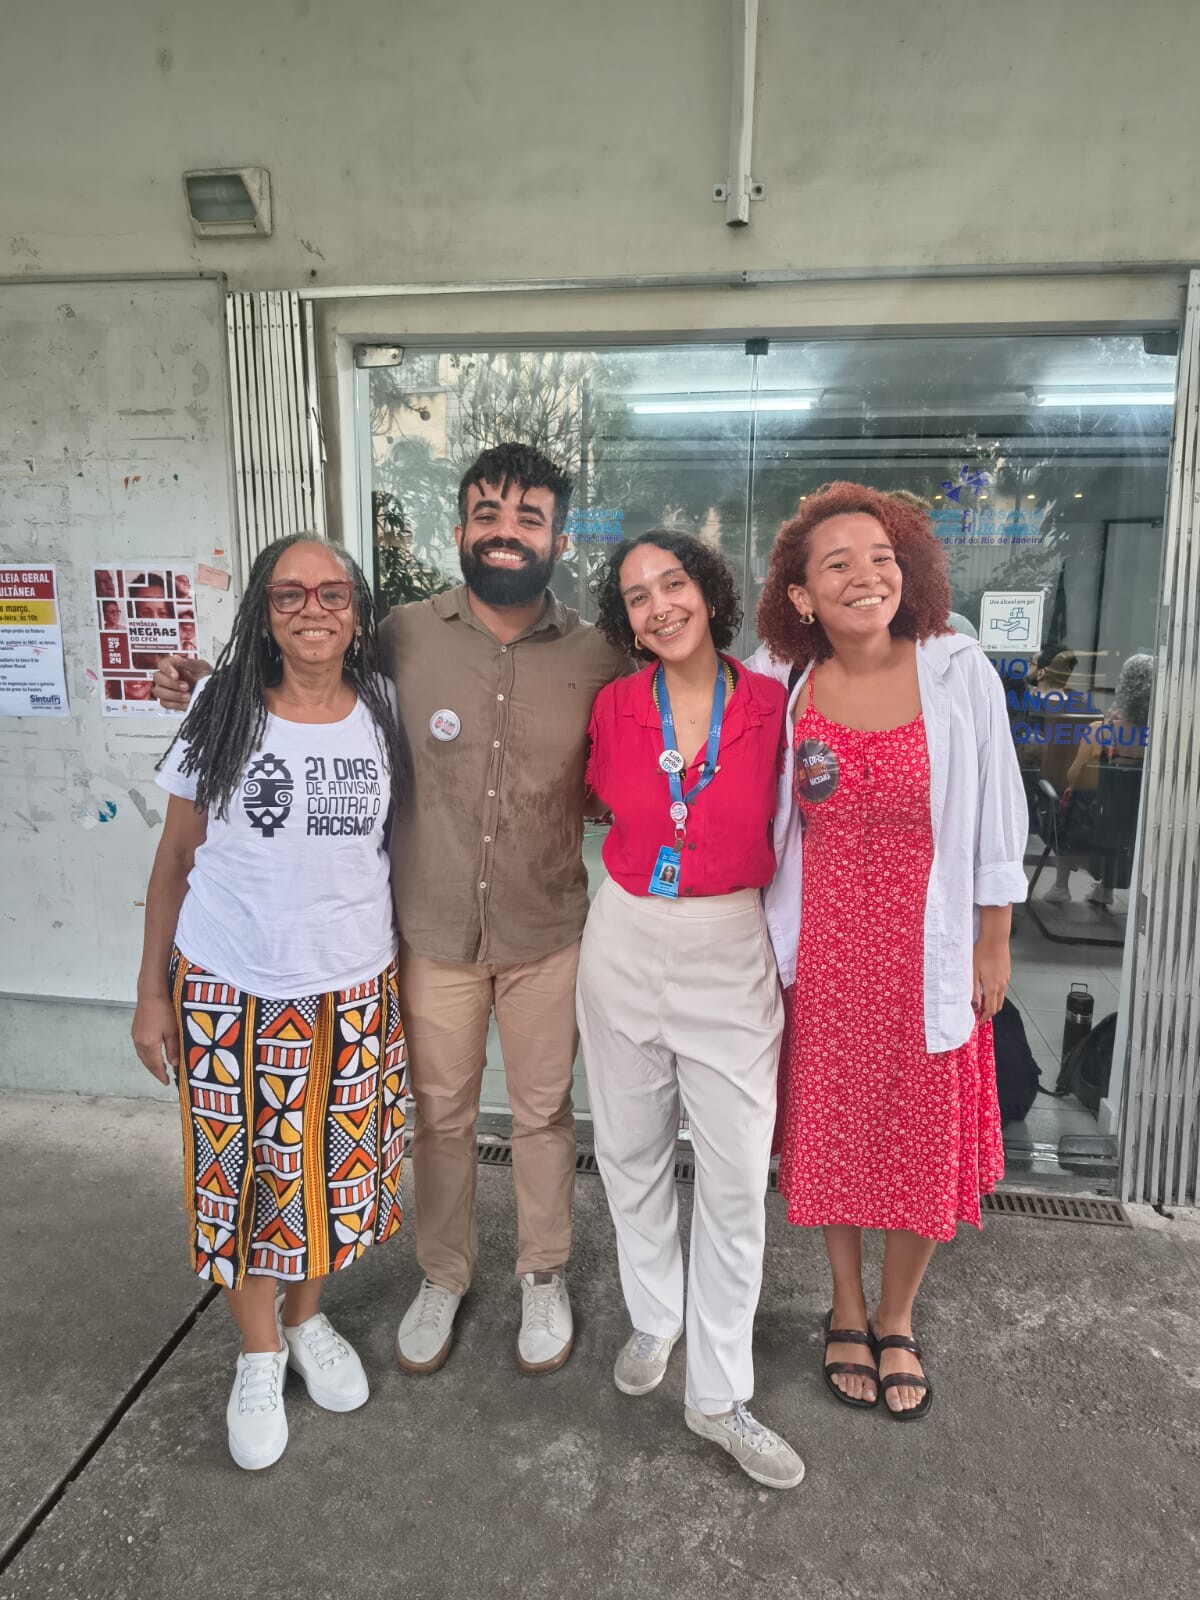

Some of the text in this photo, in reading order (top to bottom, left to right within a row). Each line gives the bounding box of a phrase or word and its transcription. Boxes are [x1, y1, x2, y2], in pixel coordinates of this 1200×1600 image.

[981, 536, 996, 545] Rio
[1010, 536, 1043, 545] Janeiro
[22, 573, 51, 584] GERAL
[129, 627, 177, 637] NEGRAS
[668, 751, 683, 764] Lute
[305, 756, 378, 781] 21 DIAS
[306, 781, 381, 796] DE ATIVISMO
[307, 796, 381, 816] CONTRA O
